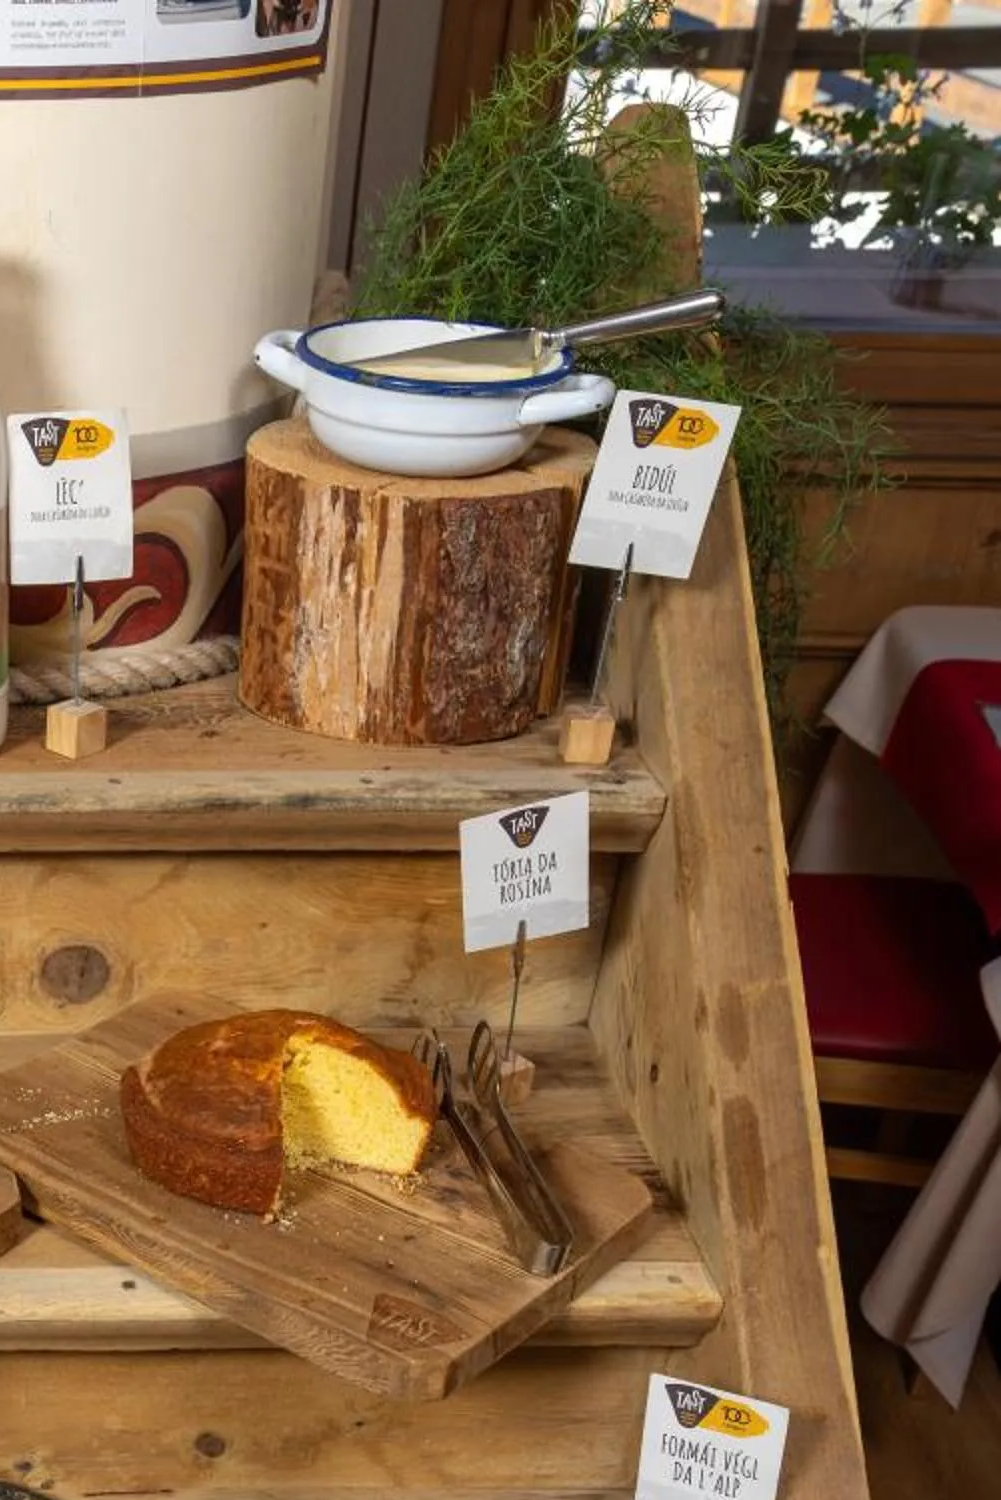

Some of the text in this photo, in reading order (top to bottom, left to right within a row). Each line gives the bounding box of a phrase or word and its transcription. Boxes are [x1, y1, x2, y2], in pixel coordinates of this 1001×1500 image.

[635, 402, 666, 430] TAST
[32, 420, 60, 447] TAST
[511, 809, 538, 834] TAST
[538, 851, 557, 873] DA
[676, 1390, 707, 1414] TAST
[673, 1461, 693, 1486] DA
